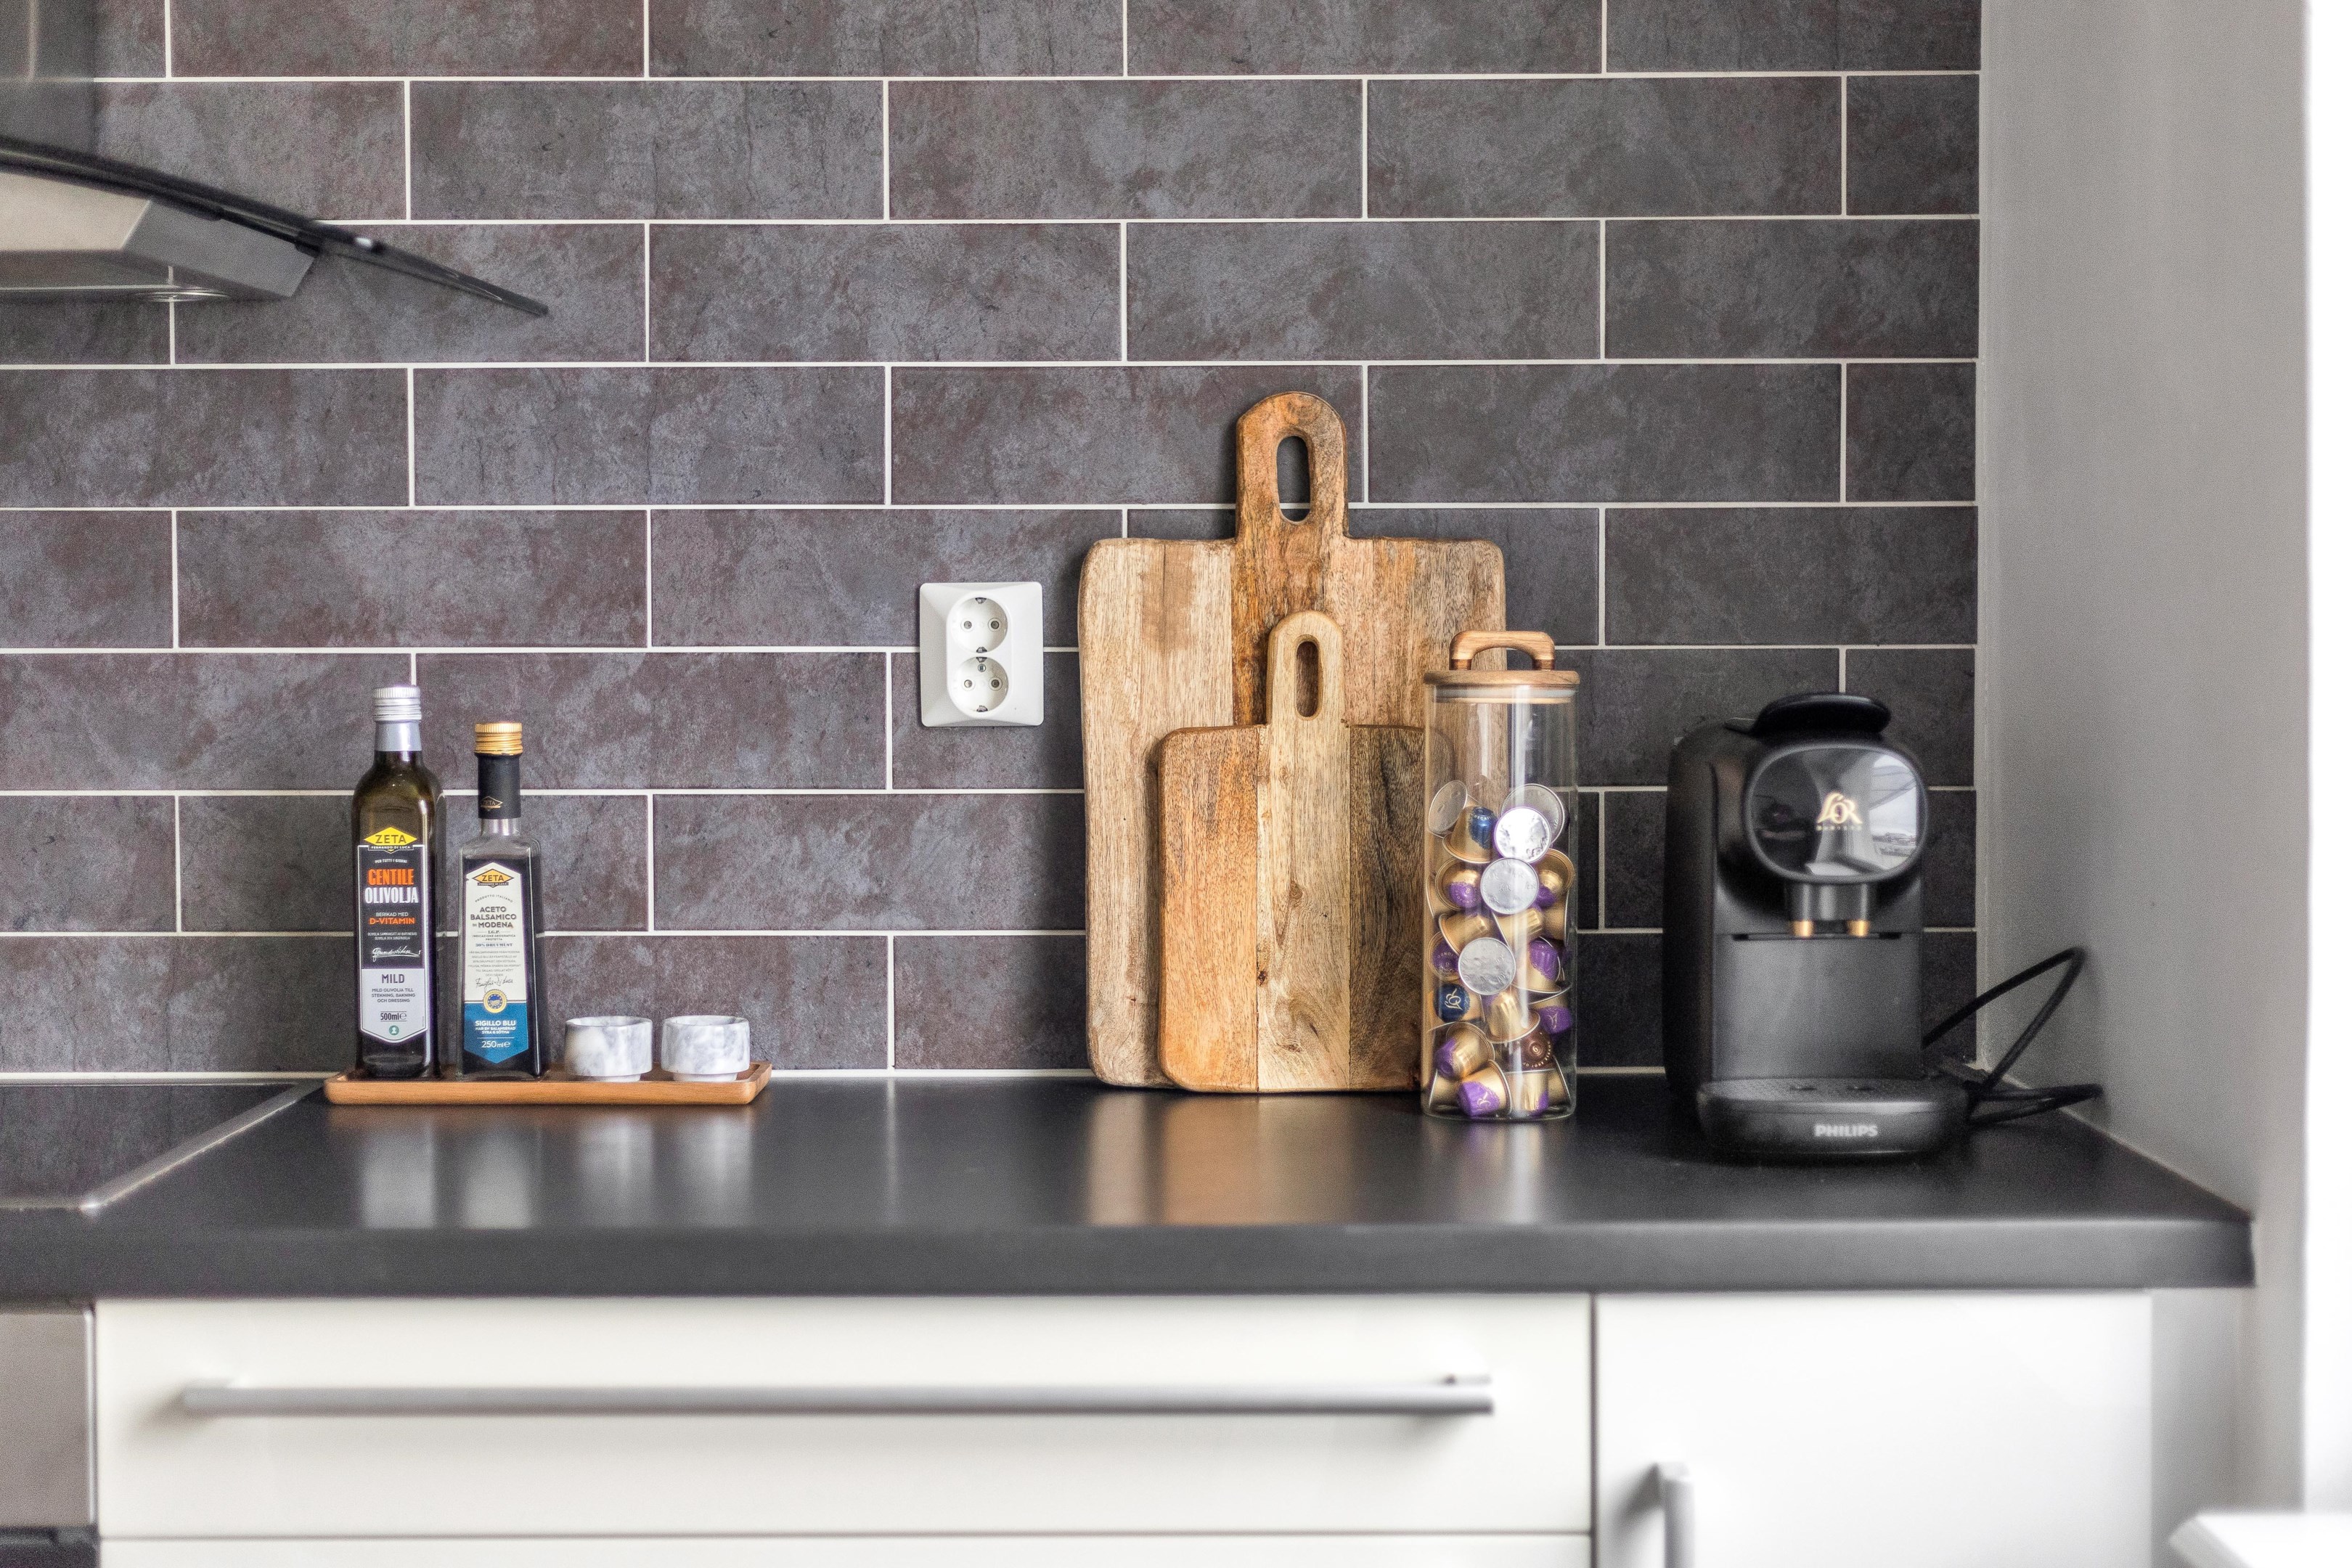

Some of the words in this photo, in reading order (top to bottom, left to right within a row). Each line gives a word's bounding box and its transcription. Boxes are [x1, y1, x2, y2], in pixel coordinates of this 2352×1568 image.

[375, 835, 407, 844] ZETA
[368, 868, 415, 886] GENTILE
[364, 887, 419, 904] OLIVOLJA
[475, 894, 495, 903] PRODOTTO
[495, 894, 513, 903] ITALIANO
[381, 973, 405, 984] MILD
[1815, 1124, 1878, 1137] PHILIPS
